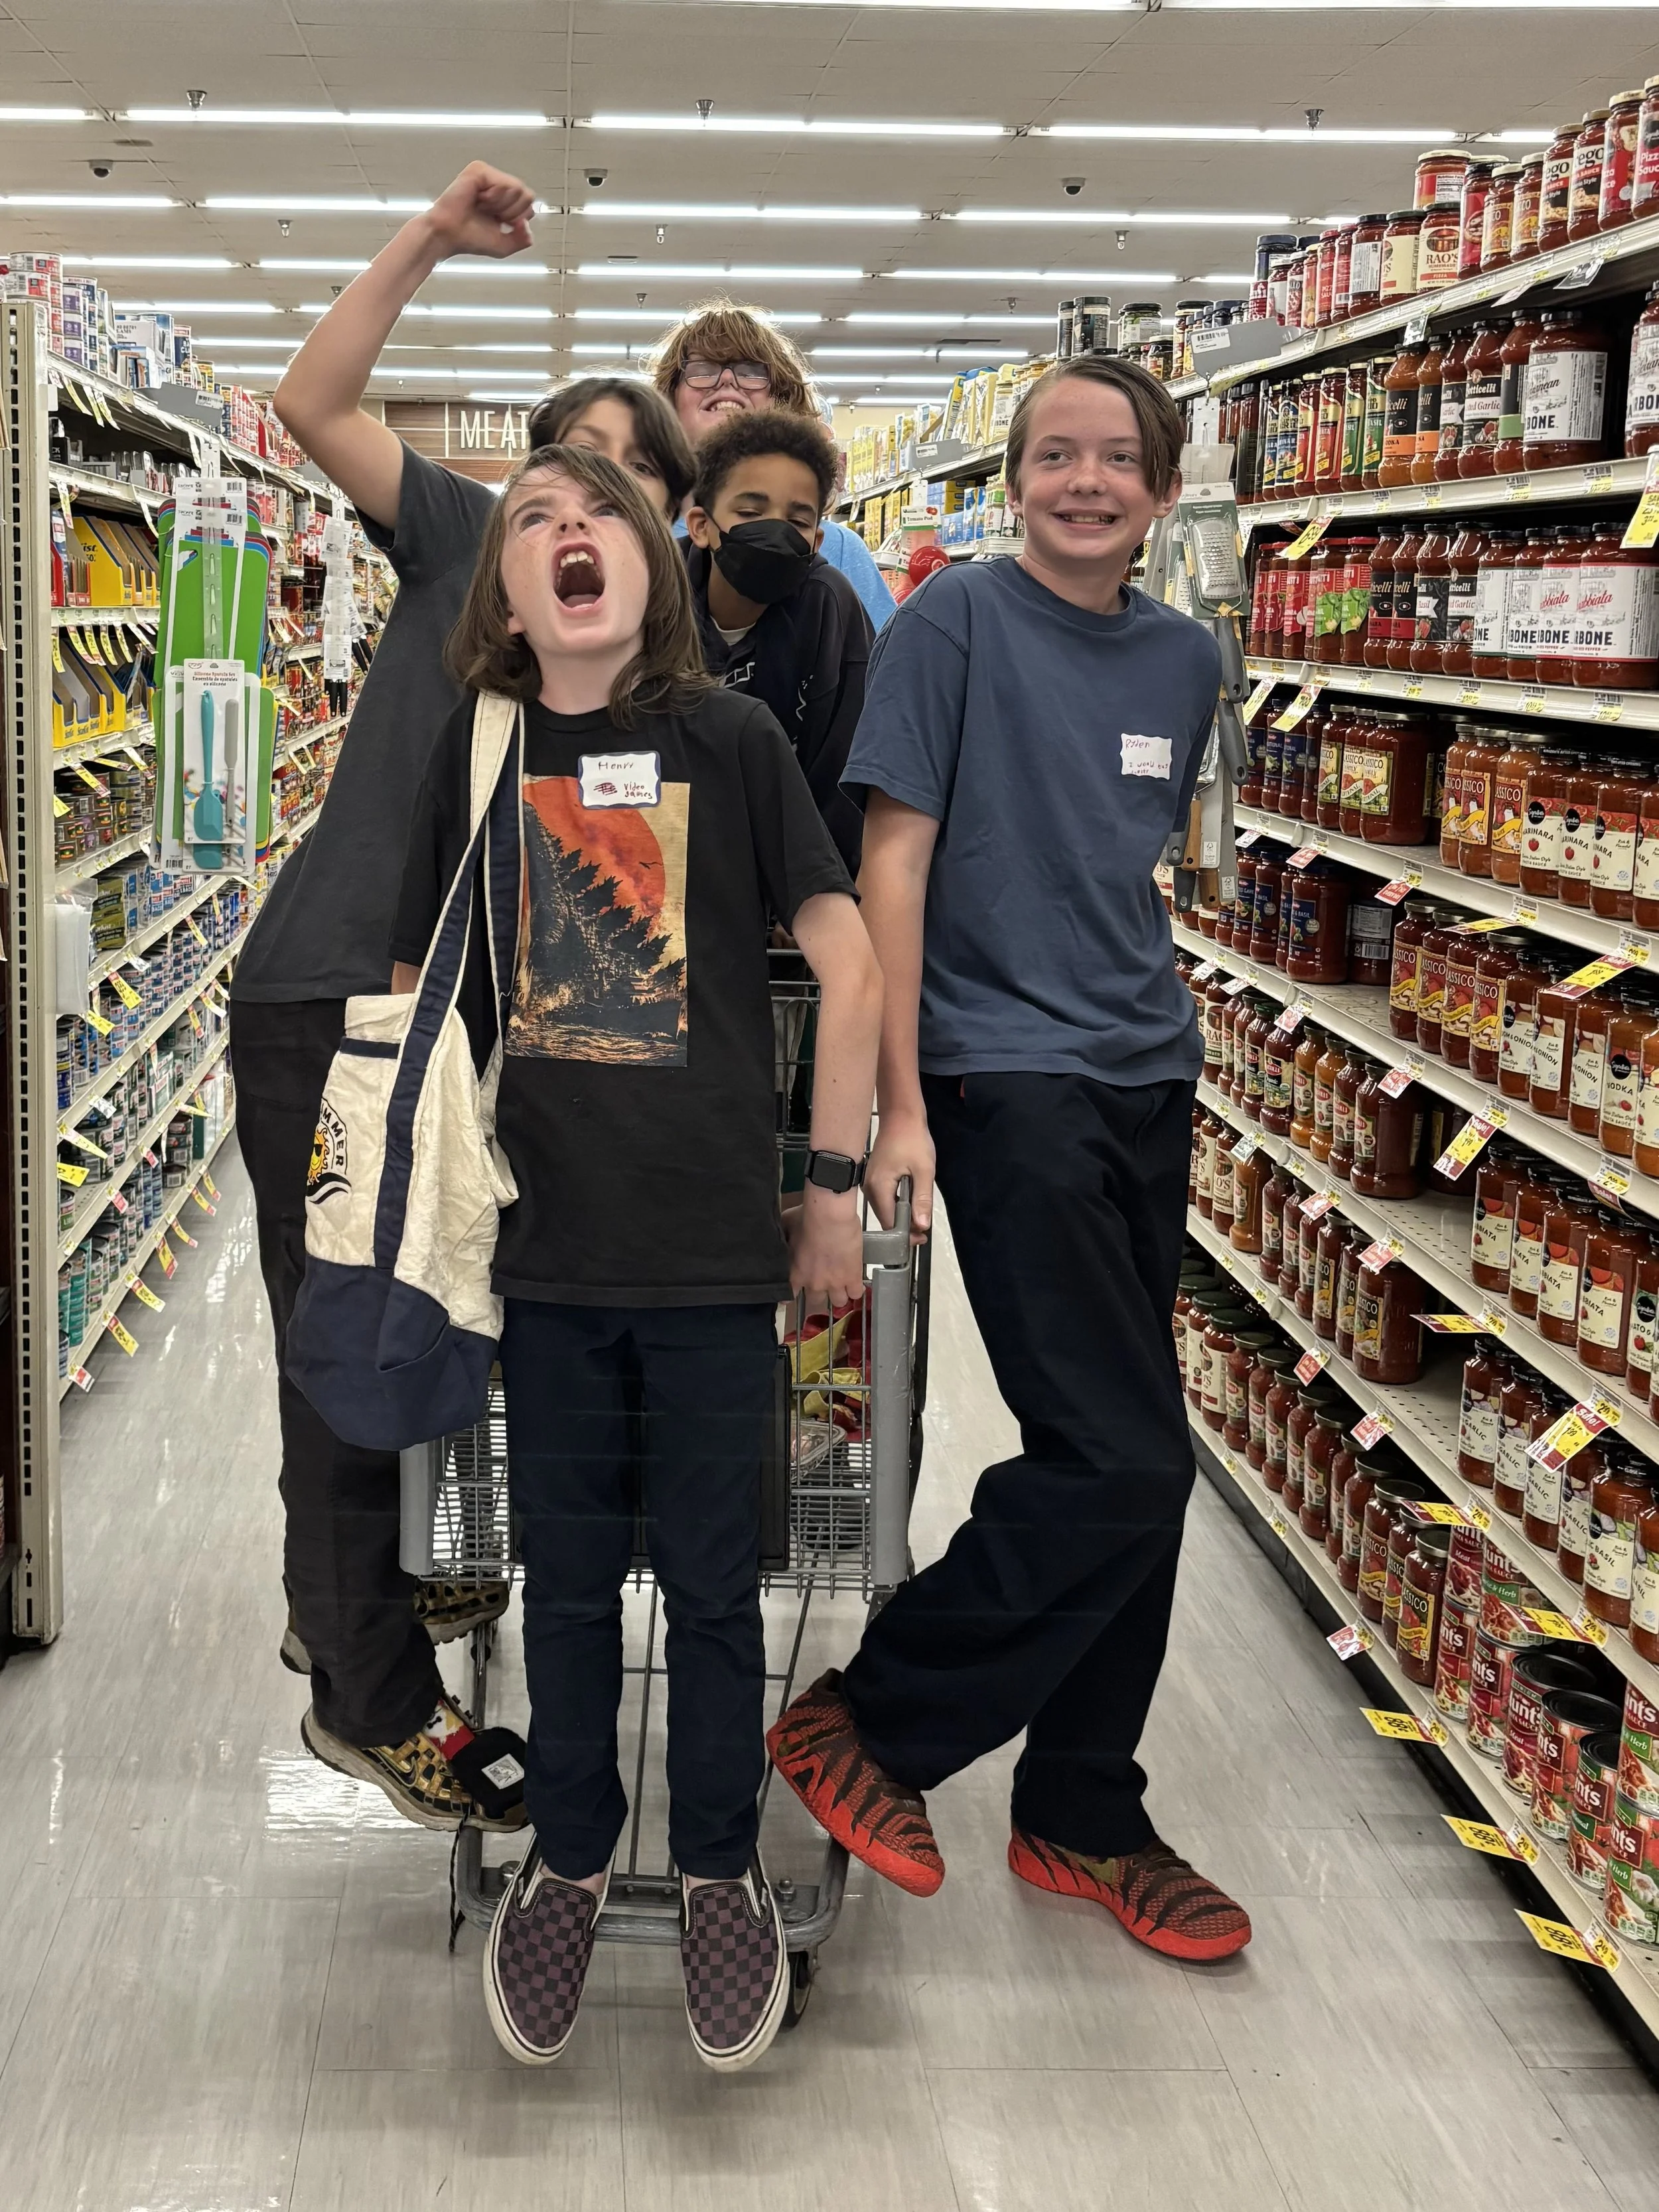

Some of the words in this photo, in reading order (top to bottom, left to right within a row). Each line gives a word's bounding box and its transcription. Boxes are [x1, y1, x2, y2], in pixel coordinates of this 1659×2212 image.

[1642, 152, 1659, 162] Pizz
[1638, 165, 1659, 175] Sauc
[461, 411, 530, 449] MEAT
[599, 761, 634, 770] Henry
[624, 791, 652, 799] games
[1577, 1408, 1601, 1426] Sale!
[1594, 1545, 1615, 1568] BASIL
[1498, 1586, 1516, 1599] Herb
[1630, 1734, 1648, 1750] Herb
[1612, 1866, 1629, 1882] Herb
